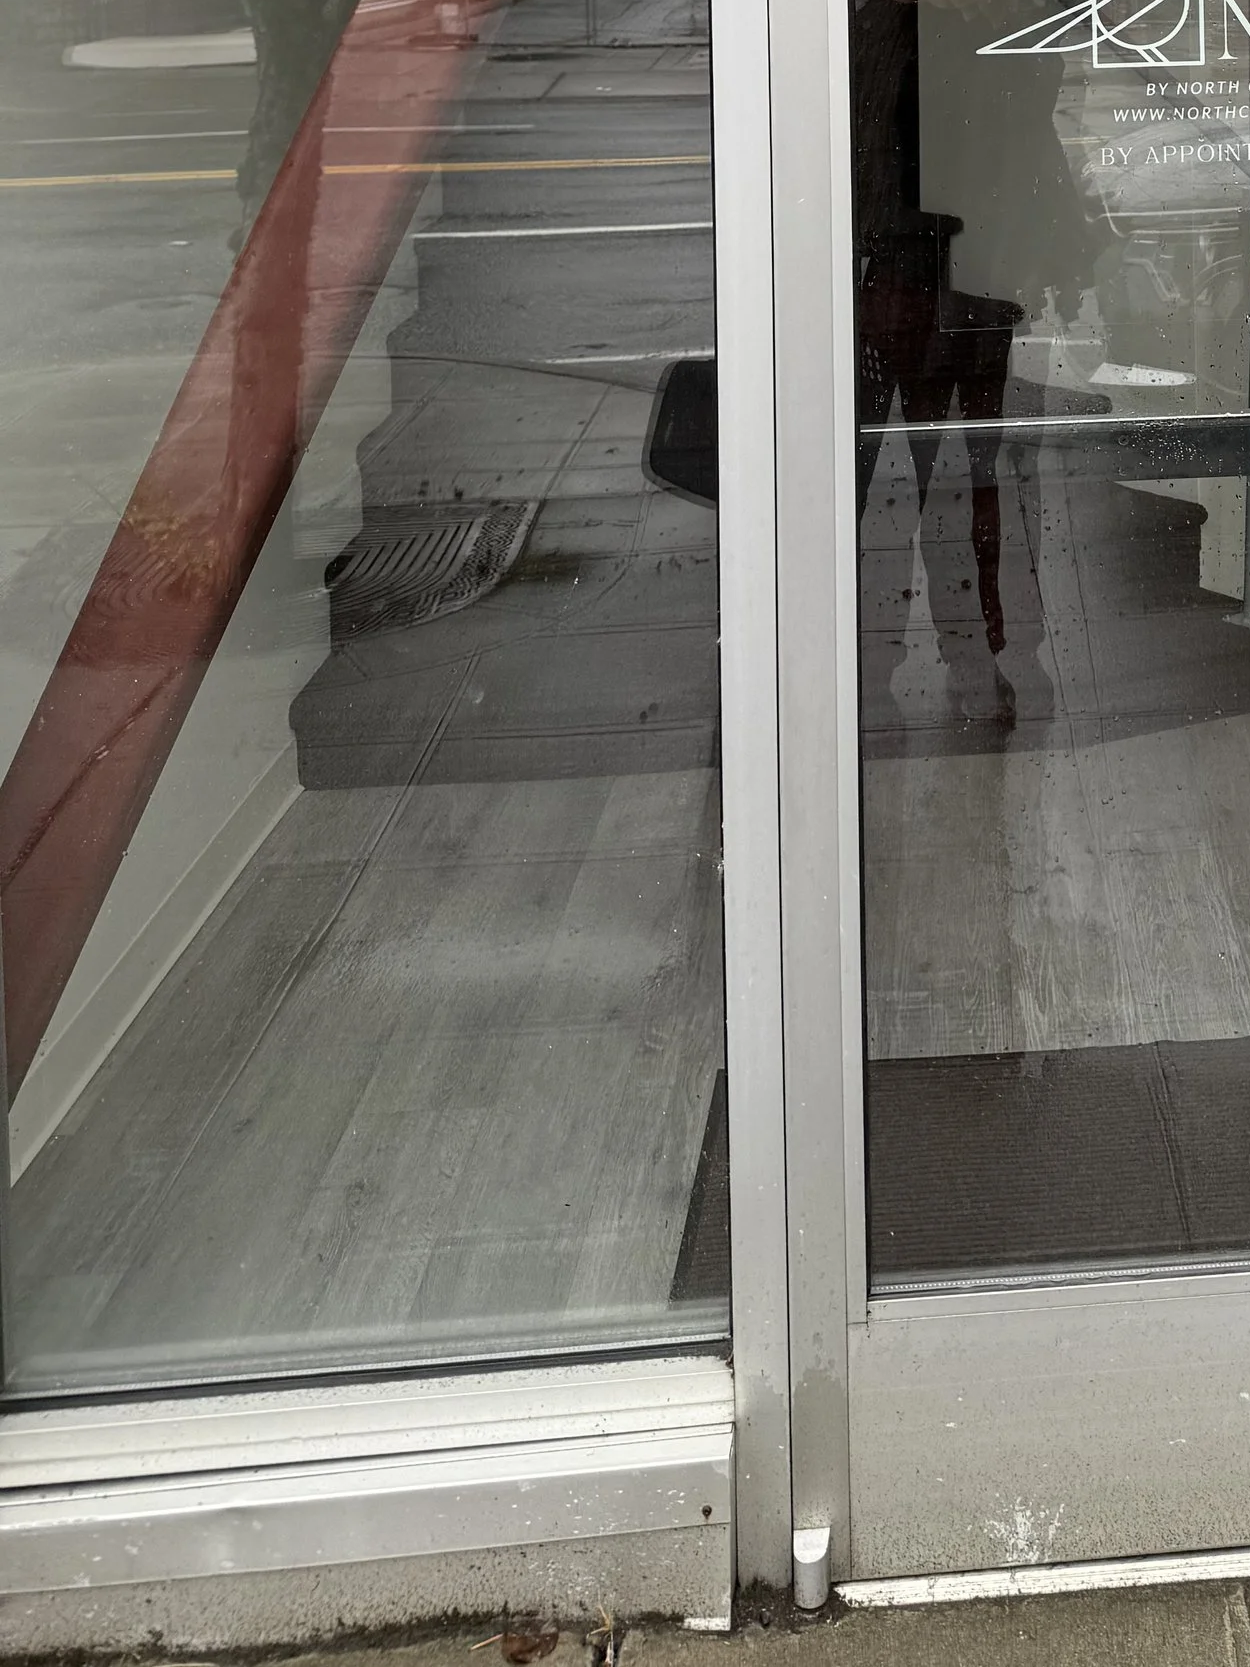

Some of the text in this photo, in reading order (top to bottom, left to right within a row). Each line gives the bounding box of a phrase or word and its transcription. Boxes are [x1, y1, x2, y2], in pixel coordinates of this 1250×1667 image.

[1146, 82, 1169, 96] BY
[1176, 80, 1240, 95] NORTH
[1101, 146, 1134, 166] BY
